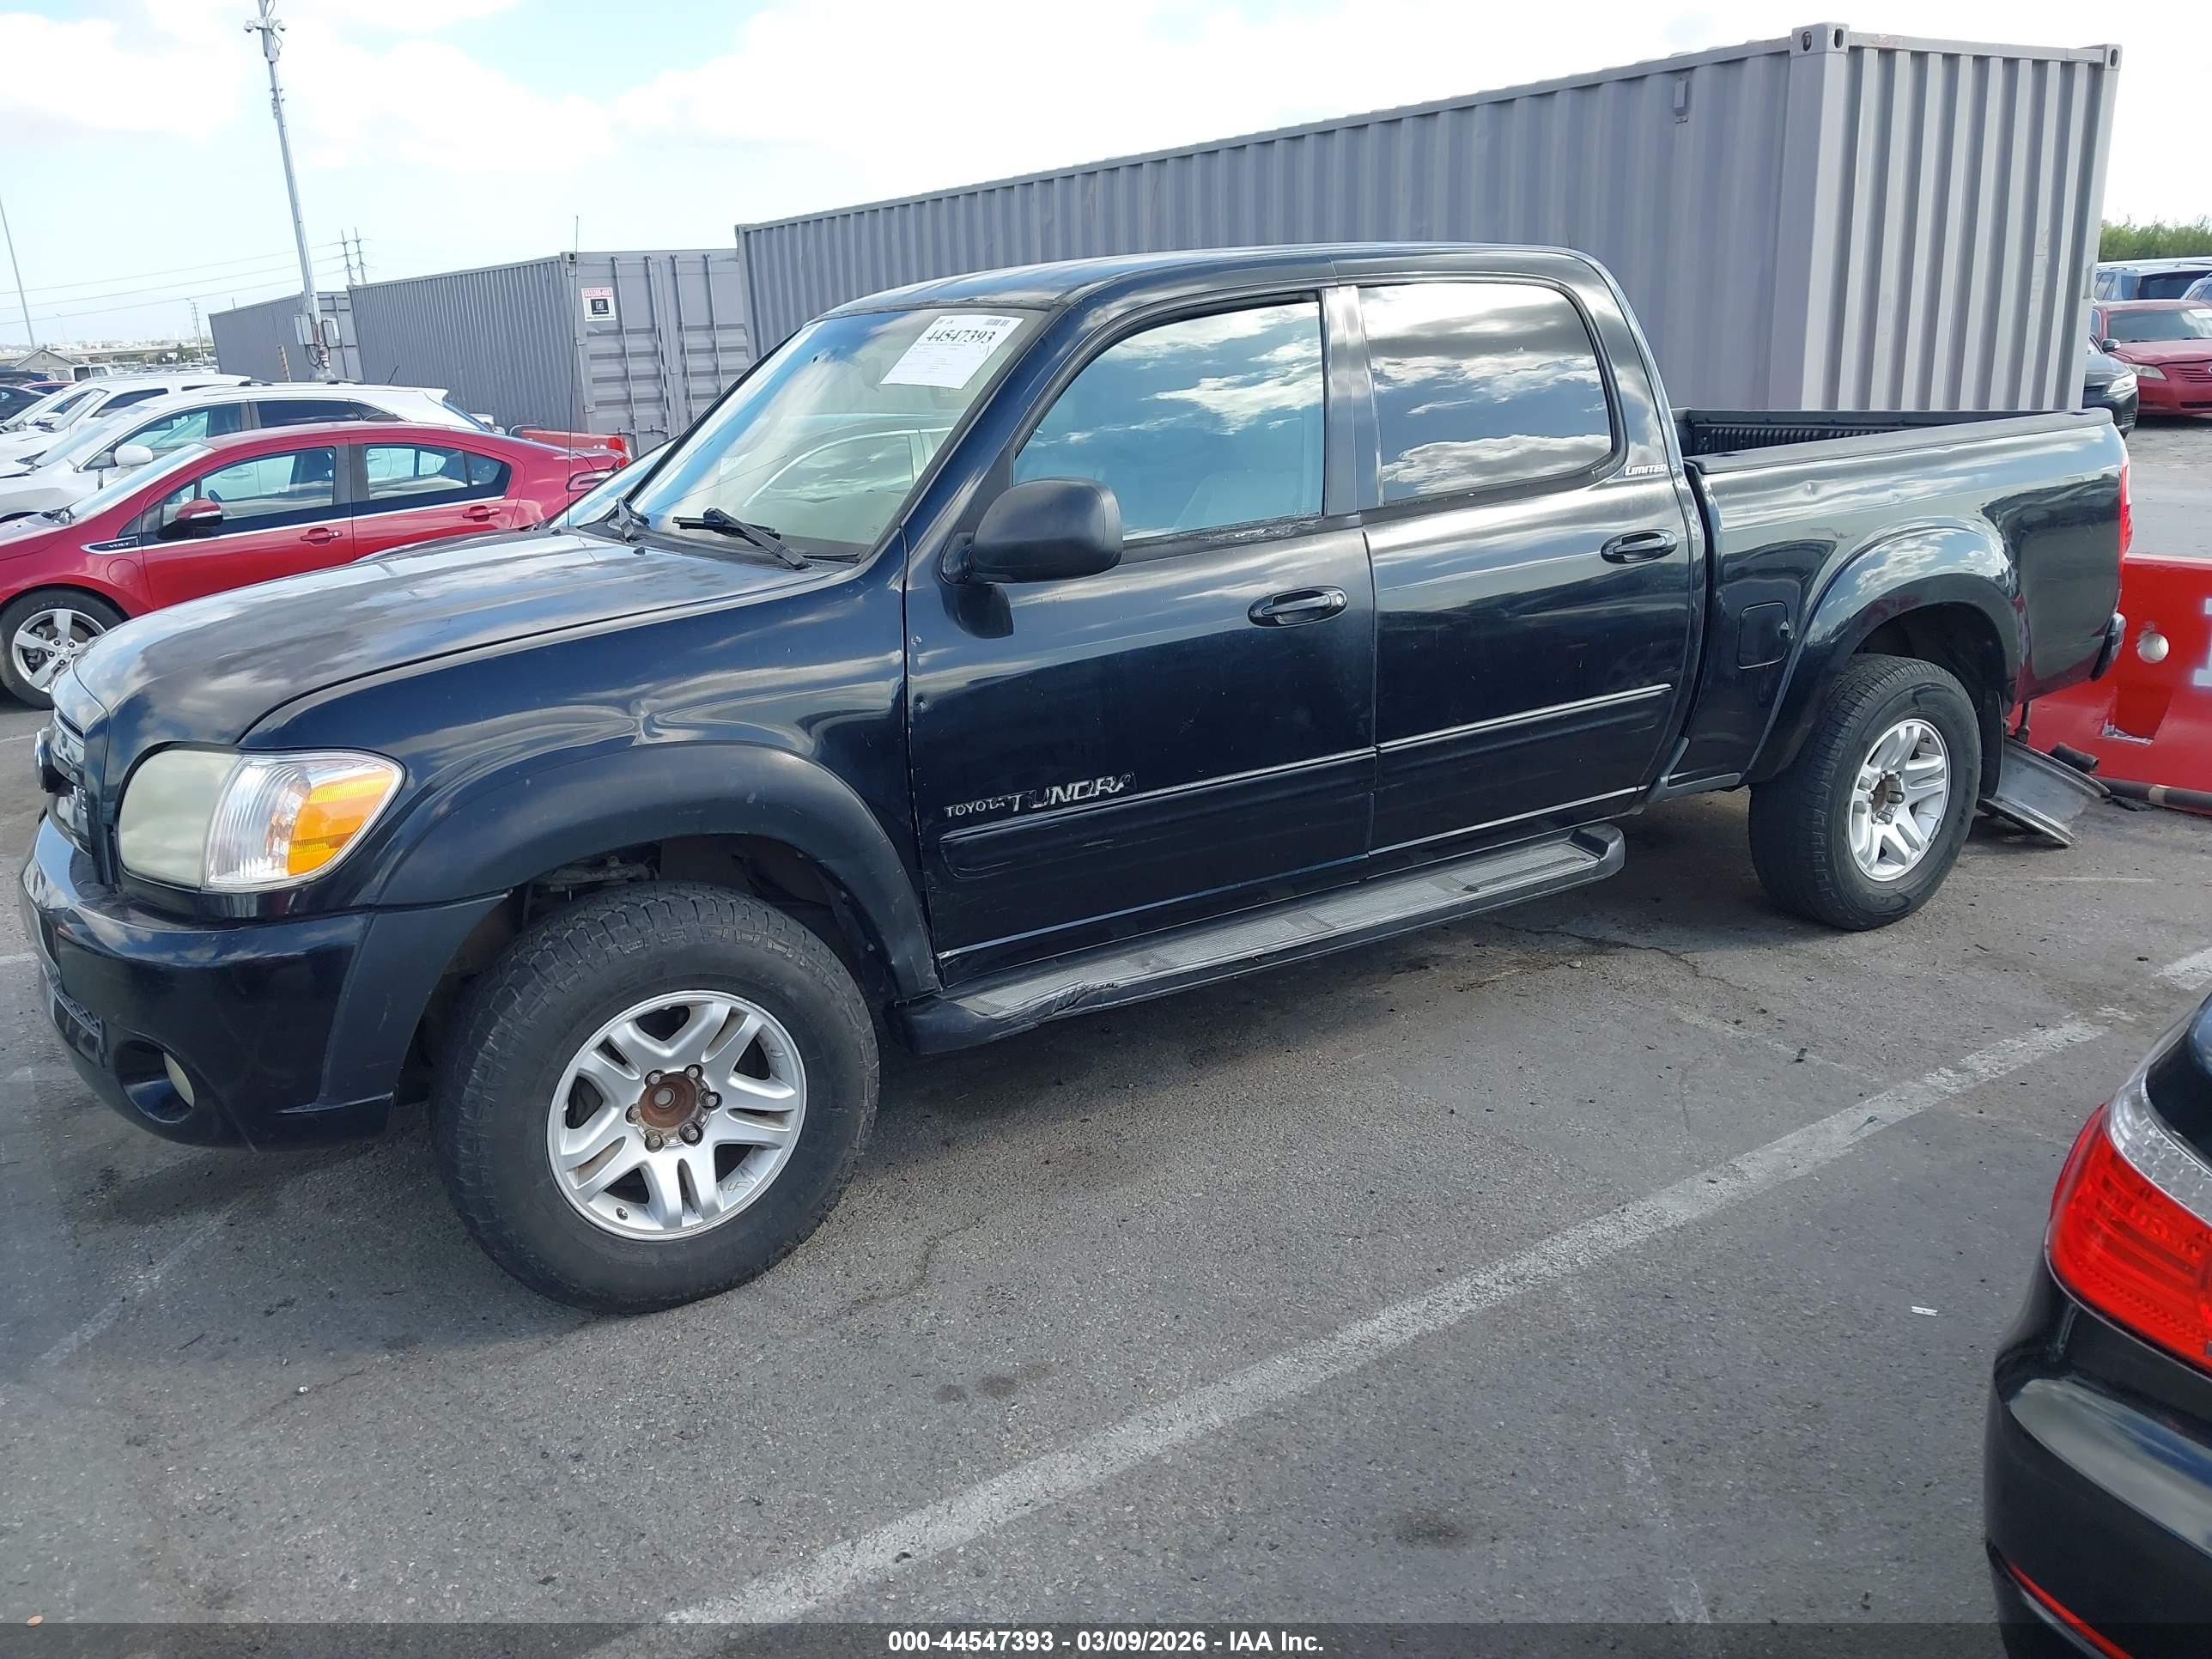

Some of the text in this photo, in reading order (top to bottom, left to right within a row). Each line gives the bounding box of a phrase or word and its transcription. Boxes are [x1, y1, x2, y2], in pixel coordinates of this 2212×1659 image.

[926, 329, 996, 343] 44547393
[1624, 464, 1667, 477] LIMITED
[944, 796, 1006, 817] TOYOTA
